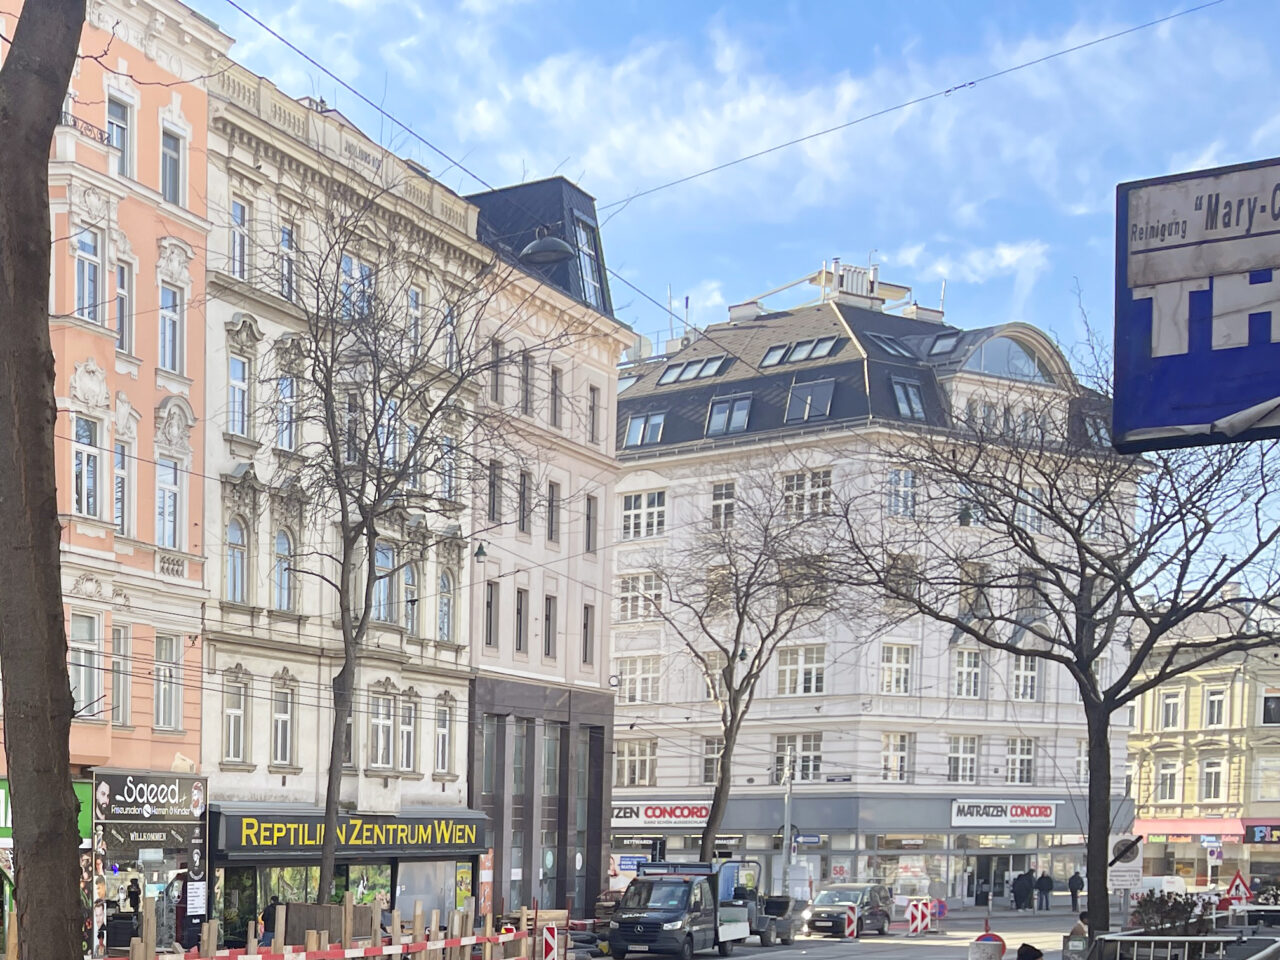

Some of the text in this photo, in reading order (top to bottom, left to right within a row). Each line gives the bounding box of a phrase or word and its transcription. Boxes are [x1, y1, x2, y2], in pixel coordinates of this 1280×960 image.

[1130, 219, 1187, 243] Reinigung
[644, 806, 709, 819] CONCORD
[957, 805, 1052, 818] MATRATZEN CONCORD
